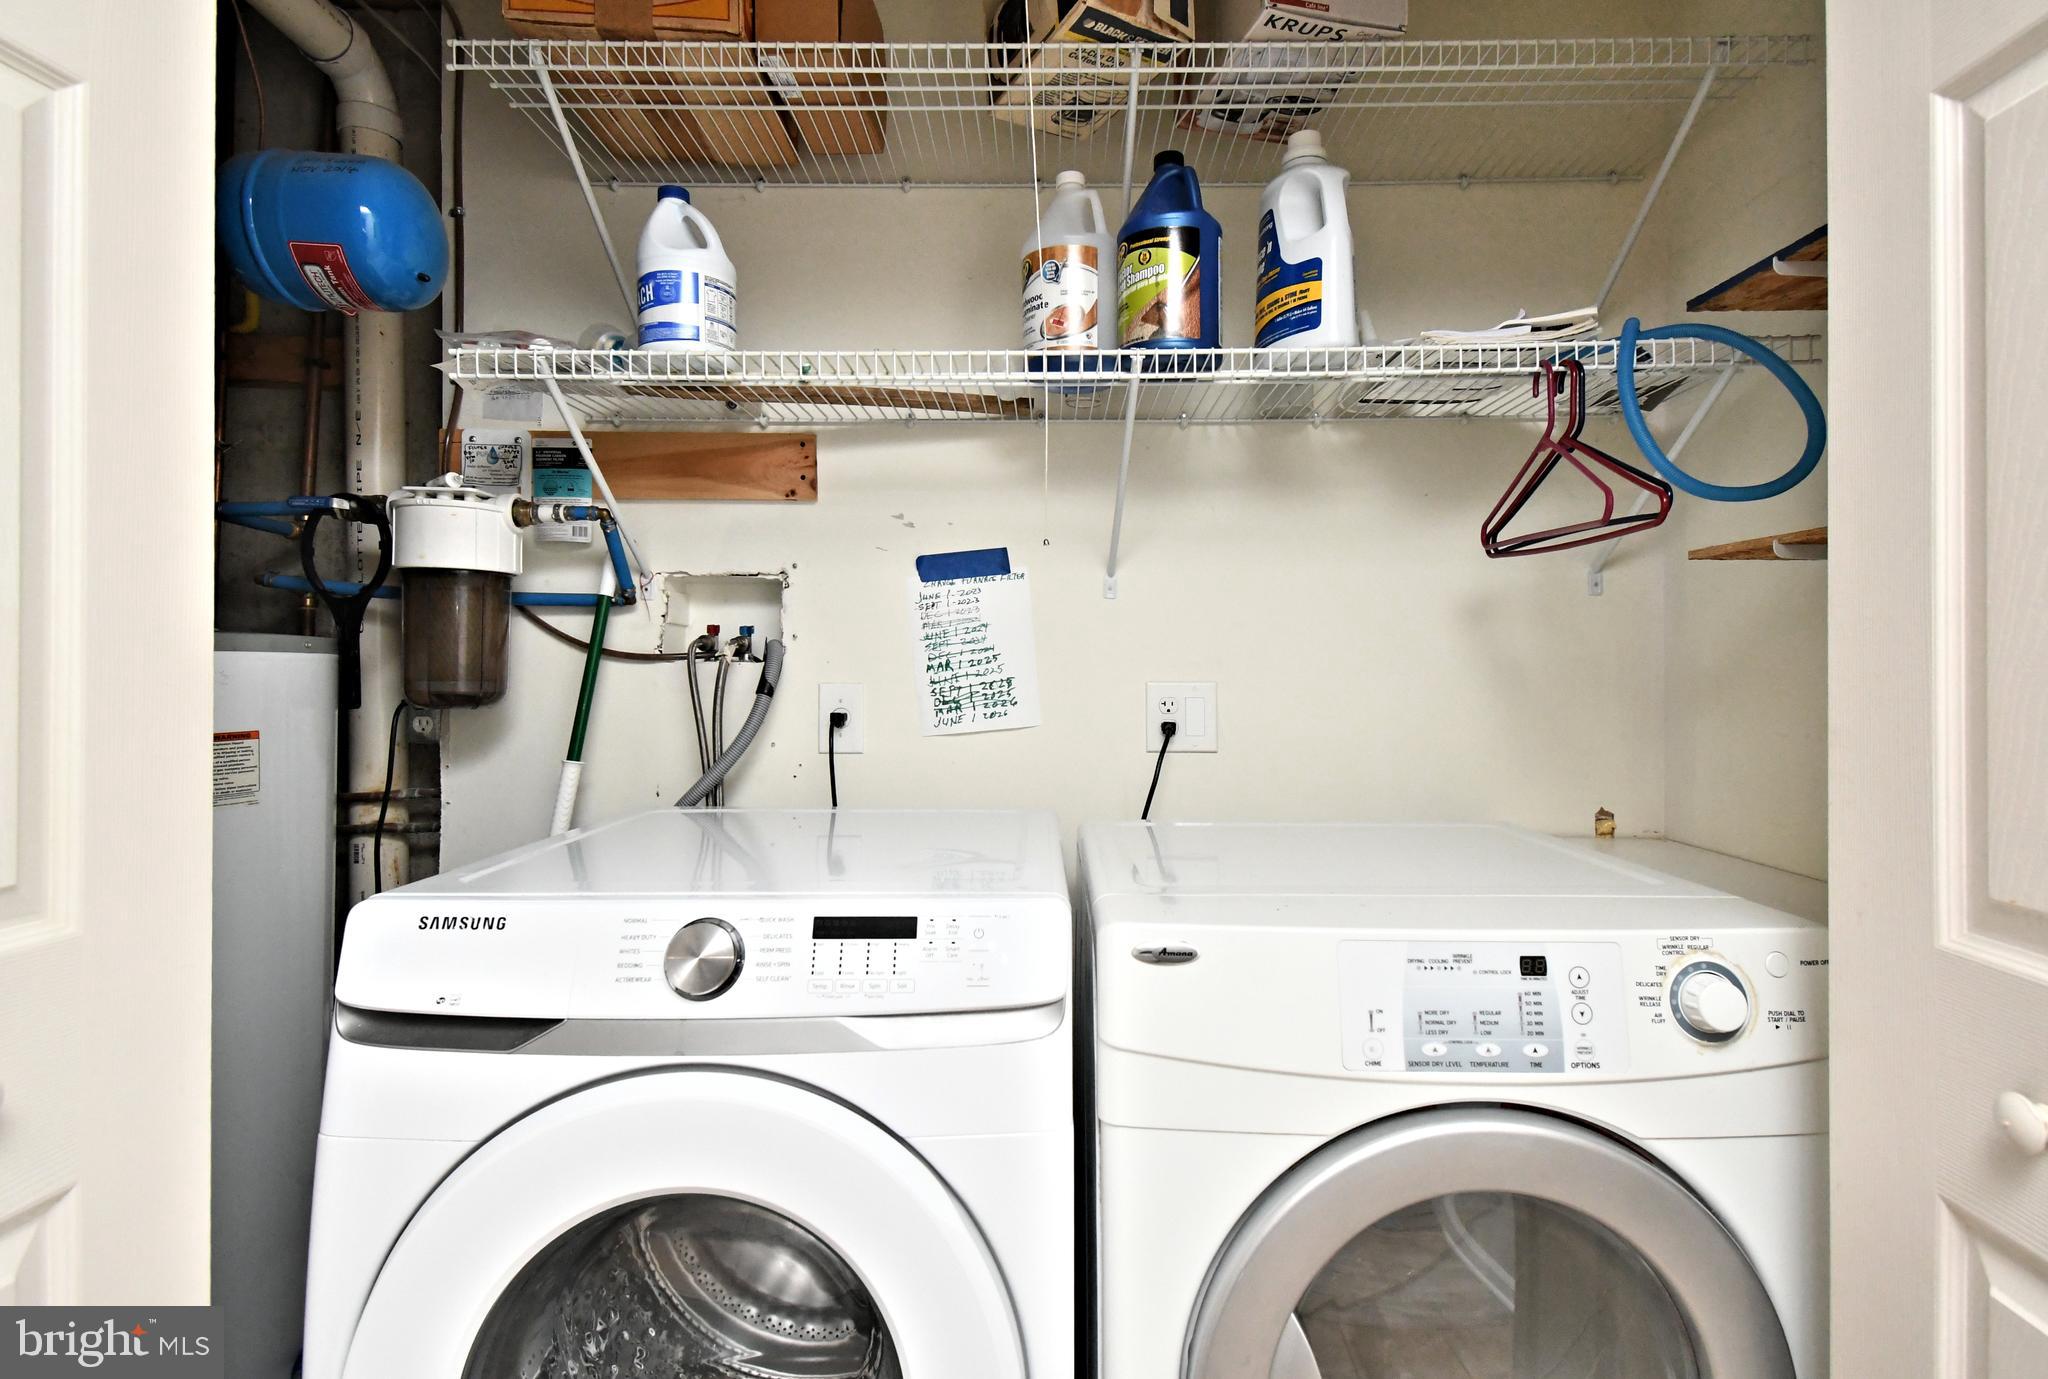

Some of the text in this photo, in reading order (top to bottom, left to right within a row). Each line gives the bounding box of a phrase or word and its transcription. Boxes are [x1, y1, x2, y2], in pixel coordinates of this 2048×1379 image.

[1092, 21, 1129, 42] BLACK
[1263, 14, 1348, 41] KRUPS
[1126, 263, 1166, 287] Shampoo
[999, 573, 1026, 582] FILTER
[915, 592, 941, 604] JUNE
[918, 600, 942, 611] SEPT
[926, 658, 954, 673] MAR
[967, 653, 1001, 667] 2025
[975, 663, 1005, 678] 2025
[930, 684, 962, 698] SEPT
[983, 697, 1018, 708] 2026
[934, 713, 966, 728] JUNE
[982, 710, 1008, 719] 2026
[418, 916, 507, 931] SAMSUNG
[1158, 947, 1193, 957] Amana
